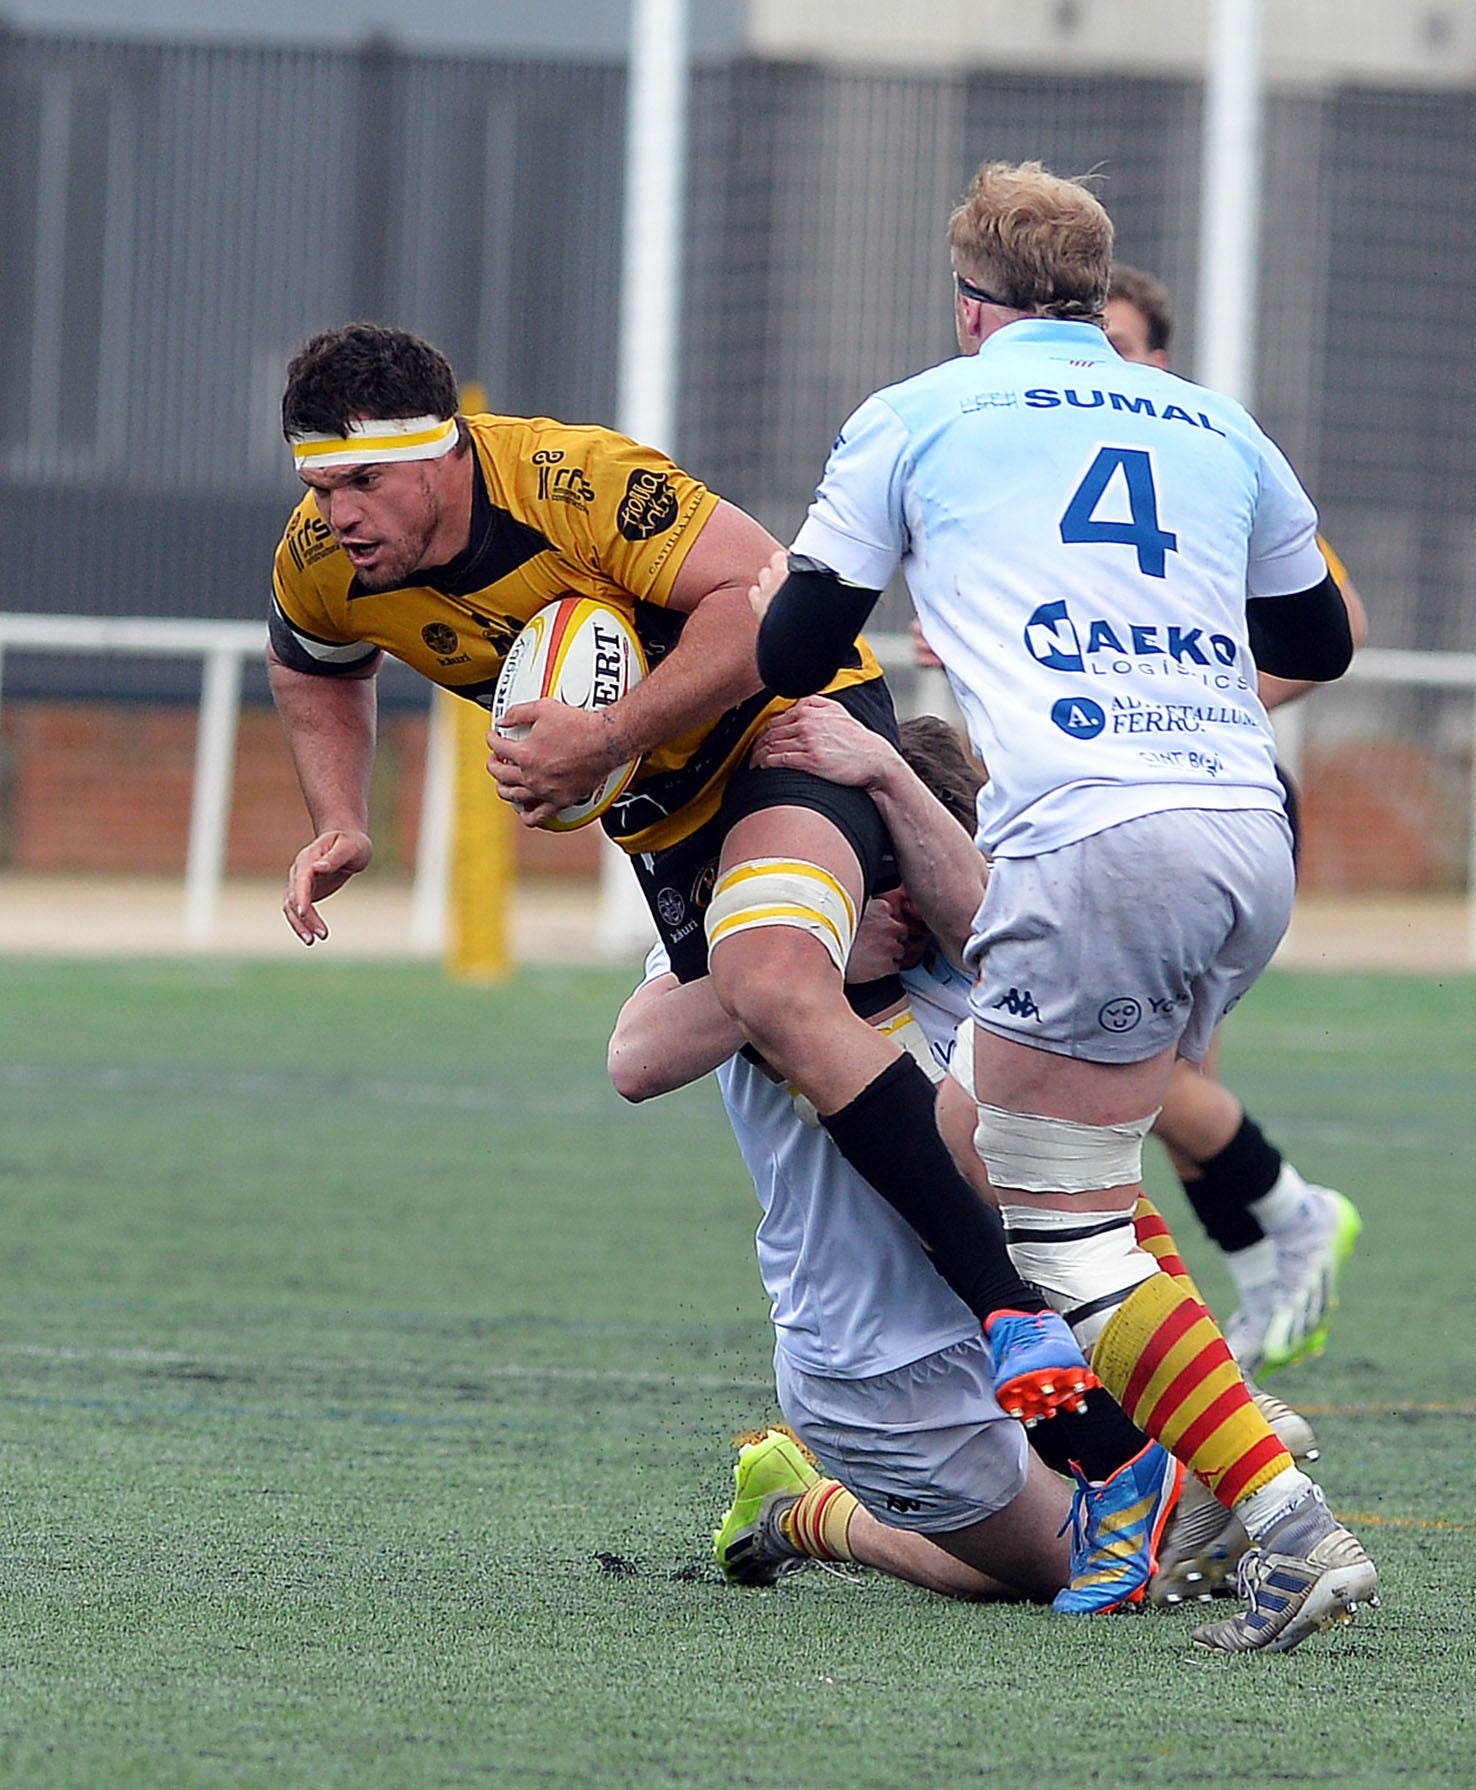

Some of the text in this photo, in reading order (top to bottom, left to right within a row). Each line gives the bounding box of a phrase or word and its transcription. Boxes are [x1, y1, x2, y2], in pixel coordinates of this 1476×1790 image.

[1024, 389, 1226, 438] SUMAL
[1059, 446, 1178, 578] 4
[648, 521, 687, 575] CASTILLA
[1024, 599, 1237, 673] NAEKO
